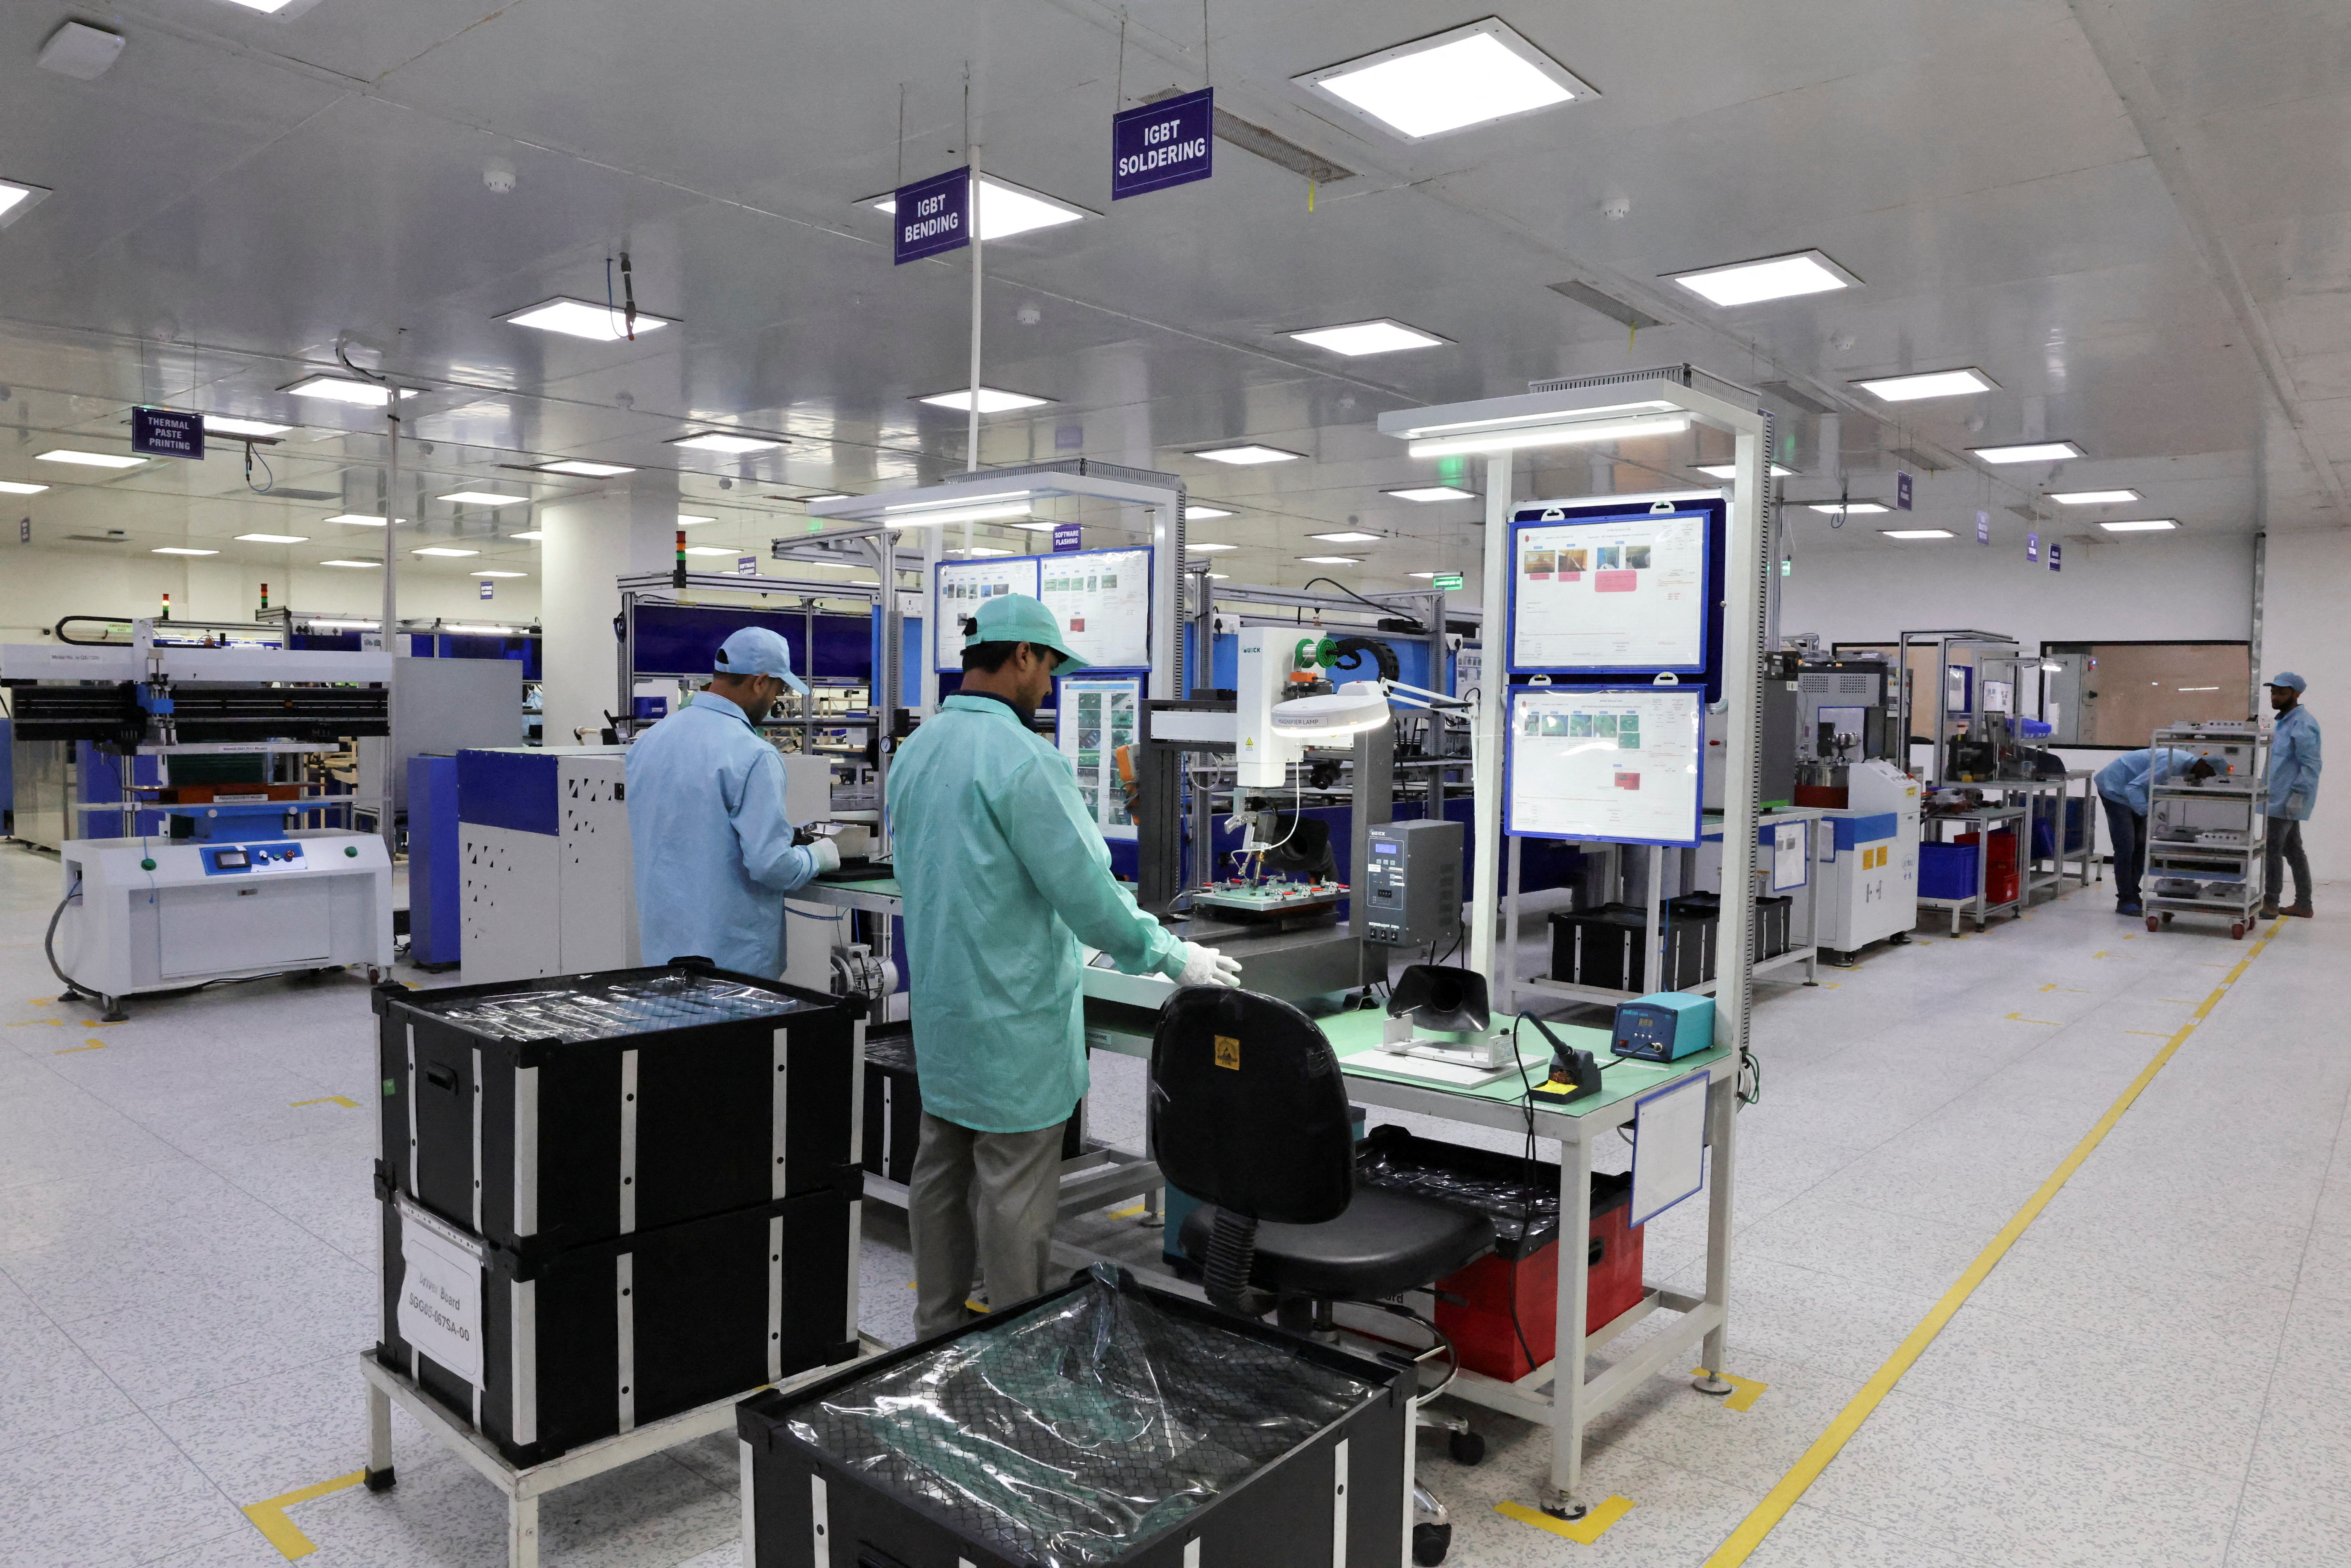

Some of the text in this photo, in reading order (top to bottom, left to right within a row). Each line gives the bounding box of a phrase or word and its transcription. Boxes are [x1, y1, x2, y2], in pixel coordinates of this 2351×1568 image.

[1144, 119, 1180, 146] IGBT
[1119, 138, 1205, 177] SOLDERING
[918, 194, 946, 217] IGBT
[905, 212, 958, 243] BENDING
[147, 417, 189, 430] THERMAL
[155, 428, 182, 439] PASTE
[150, 438, 190, 450] PRINTING
[1055, 530, 1079, 538] SOFTWARE
[1056, 537, 1078, 545] FLASHING
[419, 1272, 460, 1311] Driver Board
